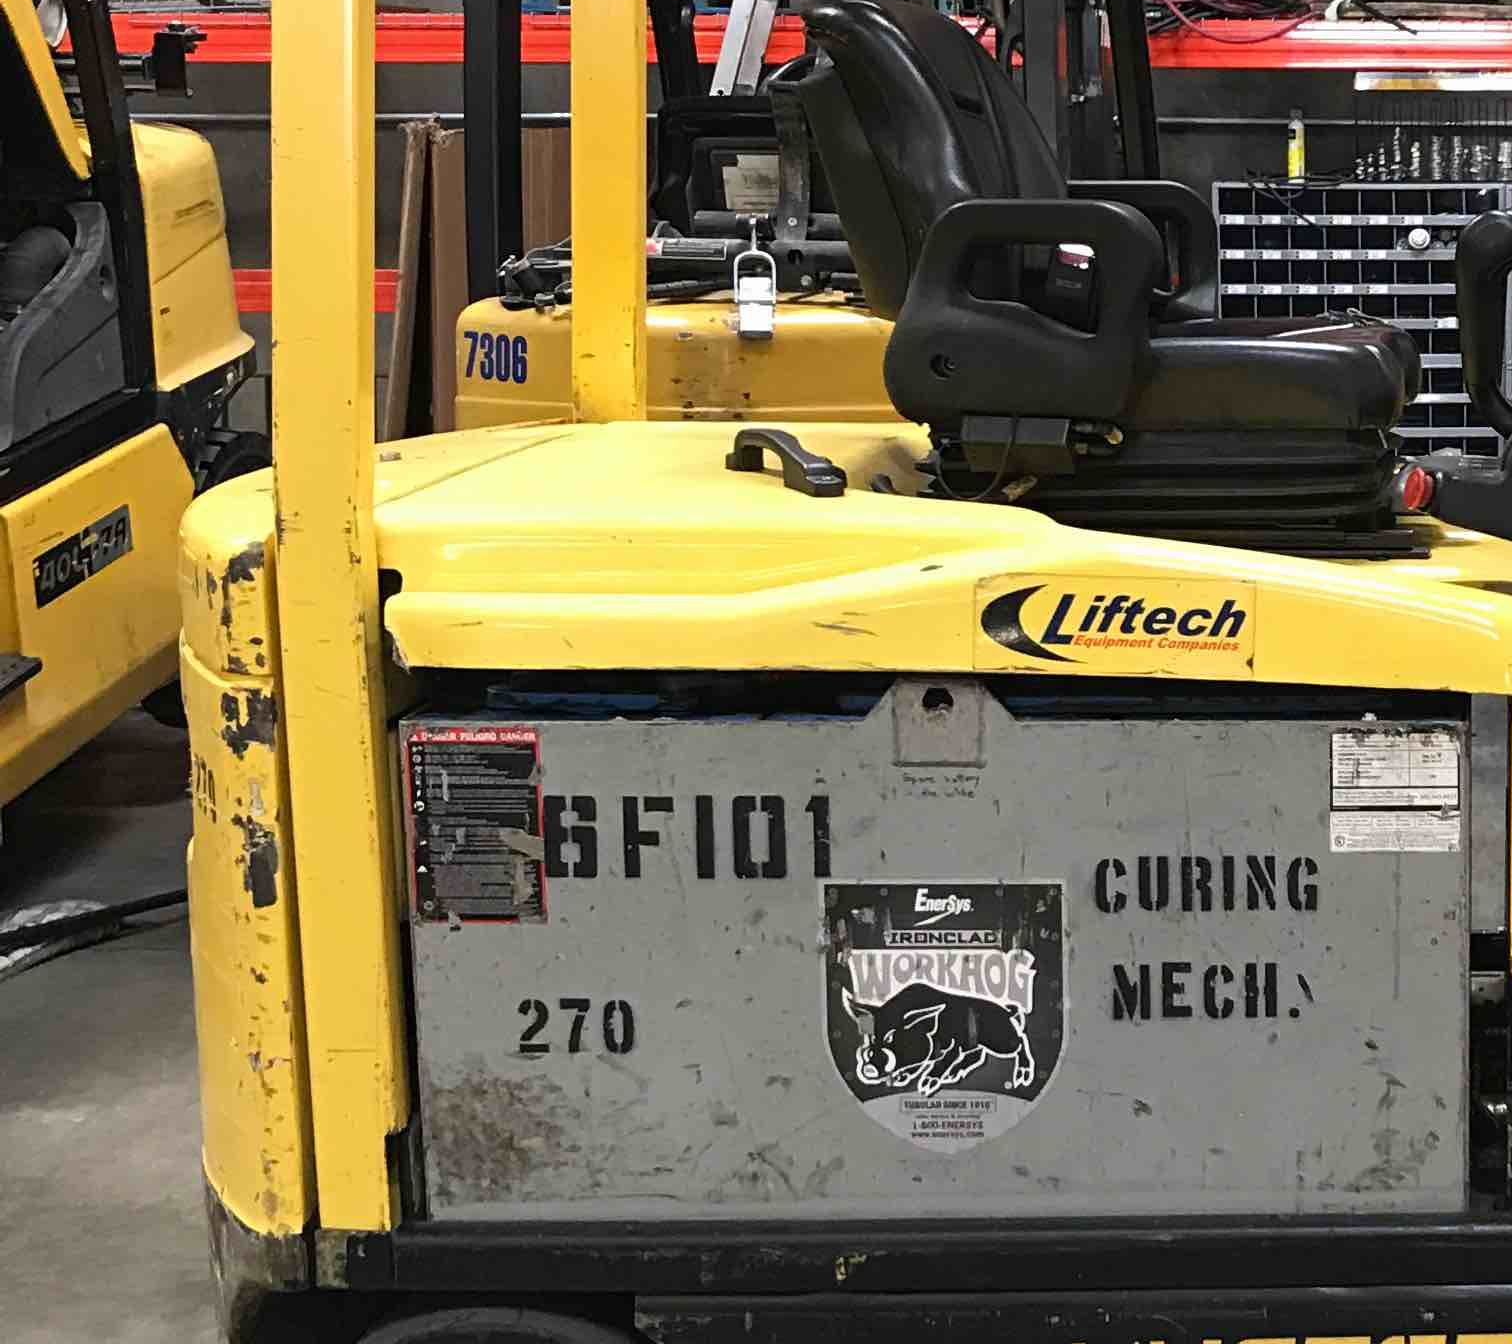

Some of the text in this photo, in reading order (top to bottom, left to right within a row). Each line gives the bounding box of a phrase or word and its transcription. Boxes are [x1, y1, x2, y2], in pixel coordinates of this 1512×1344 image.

[464, 331, 528, 384] 7306
[1040, 592, 1247, 645] Liftech
[1073, 634, 1240, 652] Equipment Companies
[1095, 855, 1319, 914] CURING
[888, 931, 999, 945] IRONCLAD
[849, 949, 1037, 1014] WORKHOG
[517, 998, 636, 1055] 270
